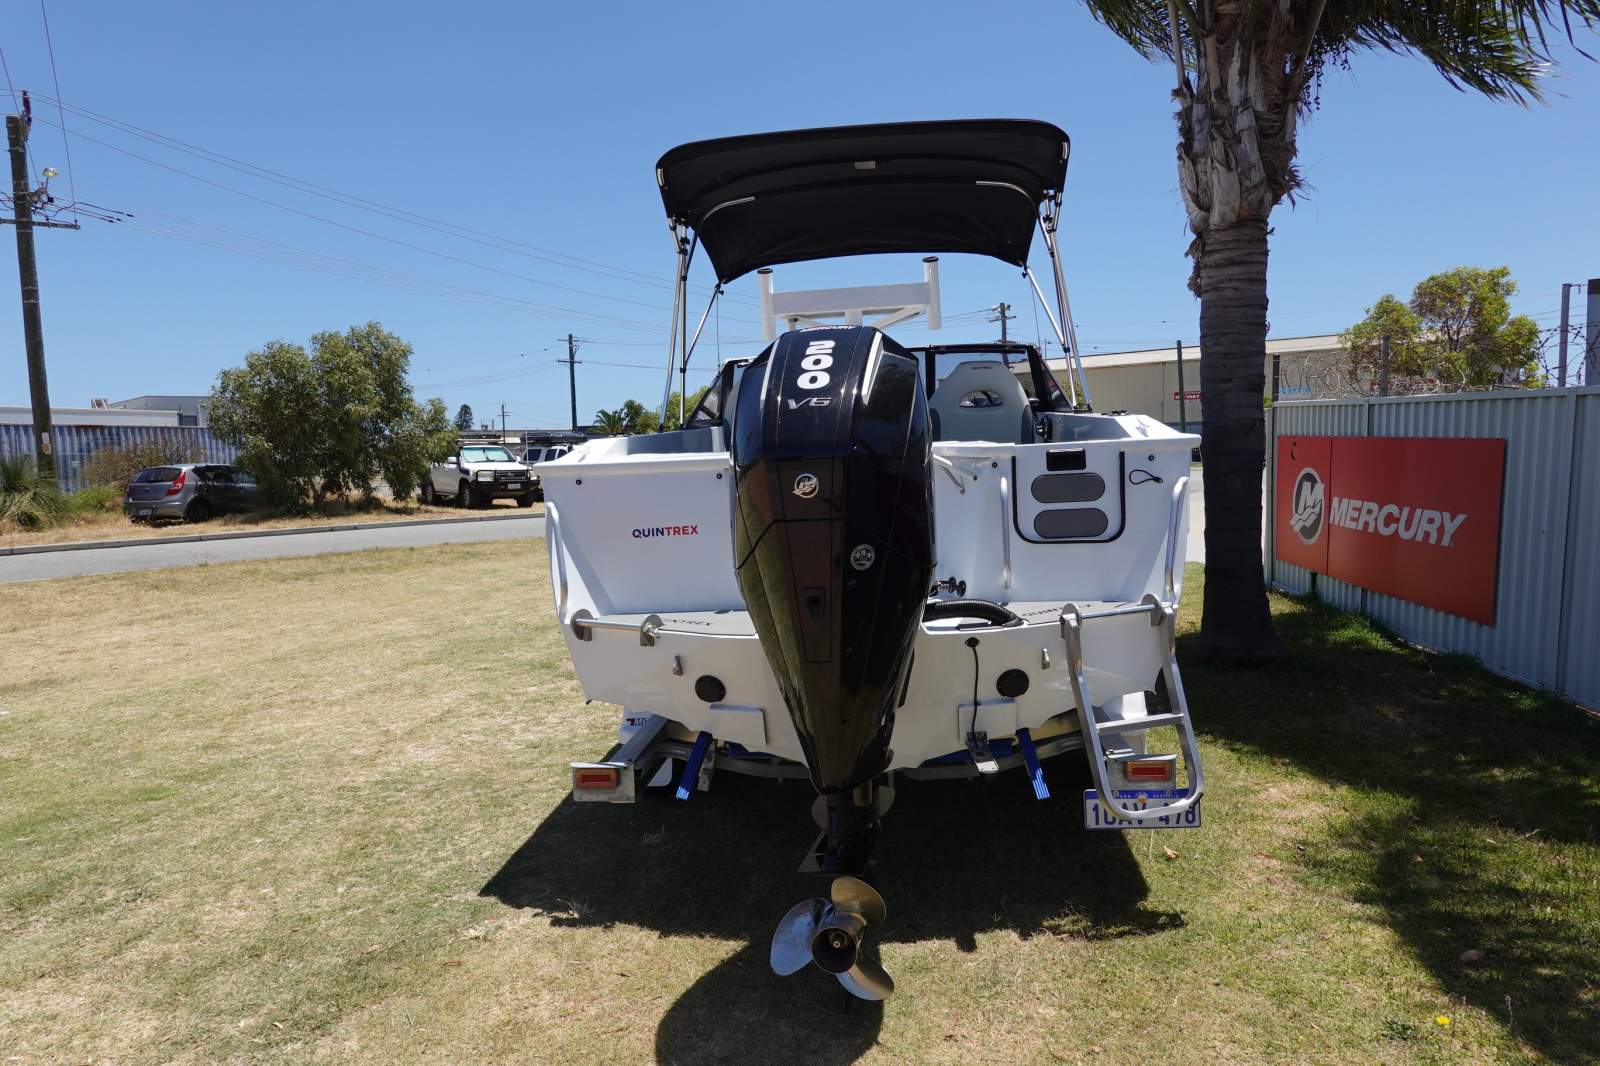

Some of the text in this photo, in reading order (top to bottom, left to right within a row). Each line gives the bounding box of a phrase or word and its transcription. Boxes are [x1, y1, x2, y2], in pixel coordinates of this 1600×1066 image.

[797, 340, 836, 390] 200
[787, 397, 831, 410] V6
[632, 524, 698, 538] QUINTREX
[1328, 496, 1468, 547] MERCURY
